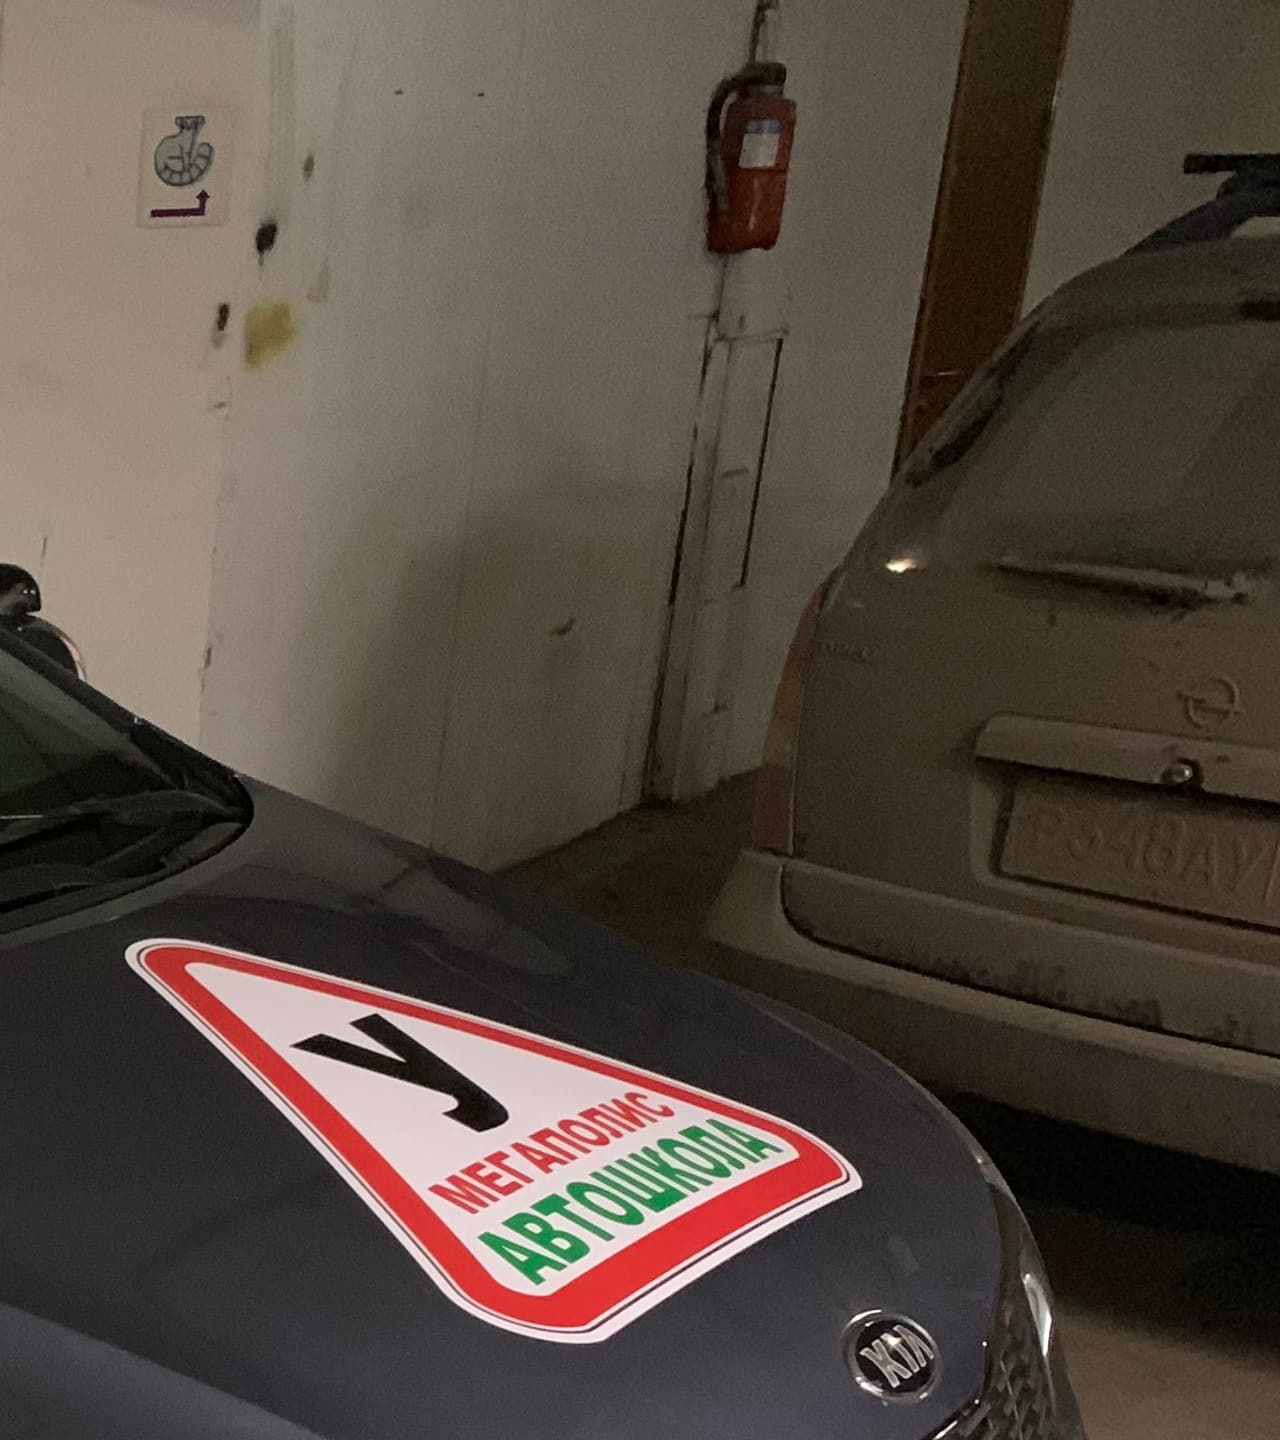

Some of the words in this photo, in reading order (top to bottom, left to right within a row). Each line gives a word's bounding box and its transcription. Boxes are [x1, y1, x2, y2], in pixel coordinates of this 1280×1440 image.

[290, 1012, 510, 1134] У
[427, 1090, 676, 1215] МЕГАПОЛИС
[476, 1116, 785, 1287] АВТОШКОЛА
[859, 1324, 935, 1389] KIA
